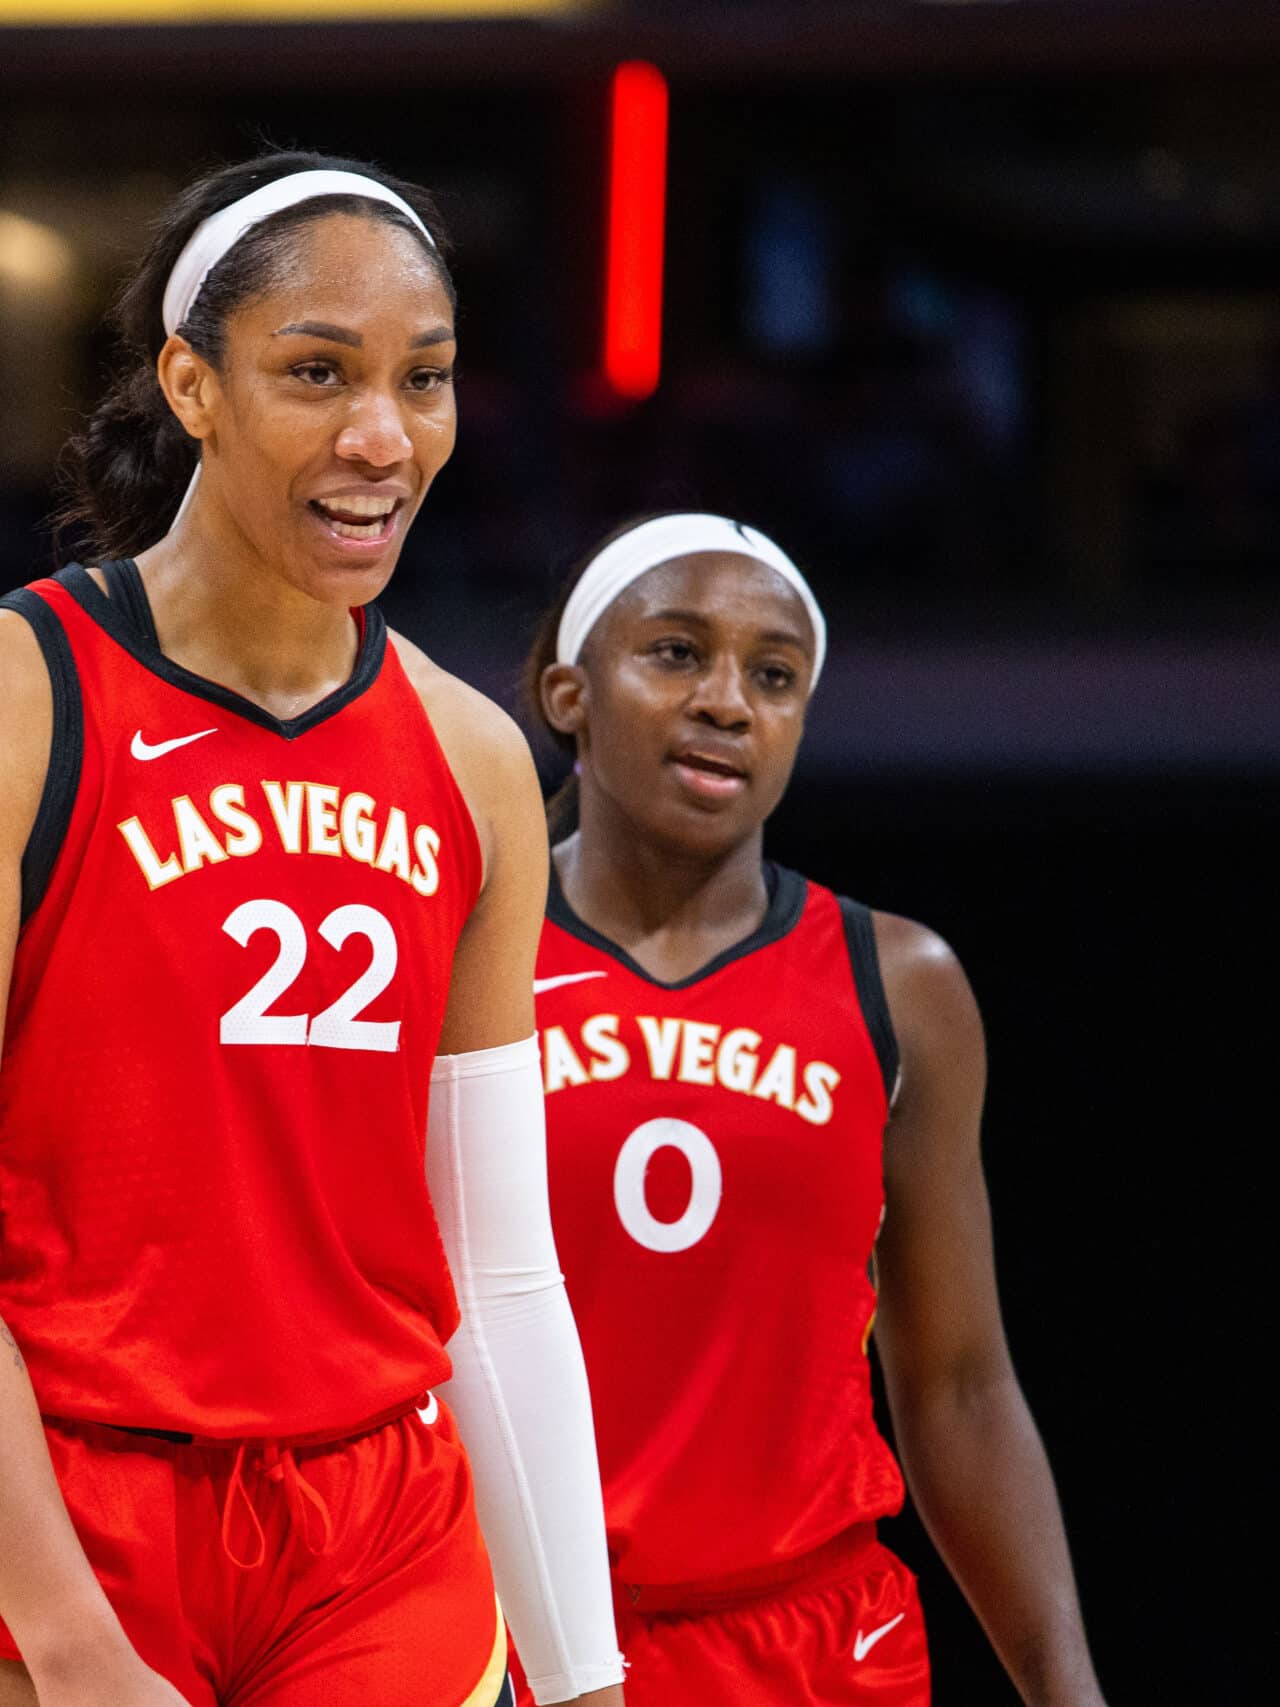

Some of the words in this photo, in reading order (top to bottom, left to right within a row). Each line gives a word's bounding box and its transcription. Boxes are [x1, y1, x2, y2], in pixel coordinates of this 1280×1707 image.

[117, 783, 262, 891] LAS
[261, 780, 441, 897] VEGAS
[219, 898, 402, 1053] 22
[636, 1015, 842, 1126] VEGAS
[613, 1116, 723, 1253] 0
